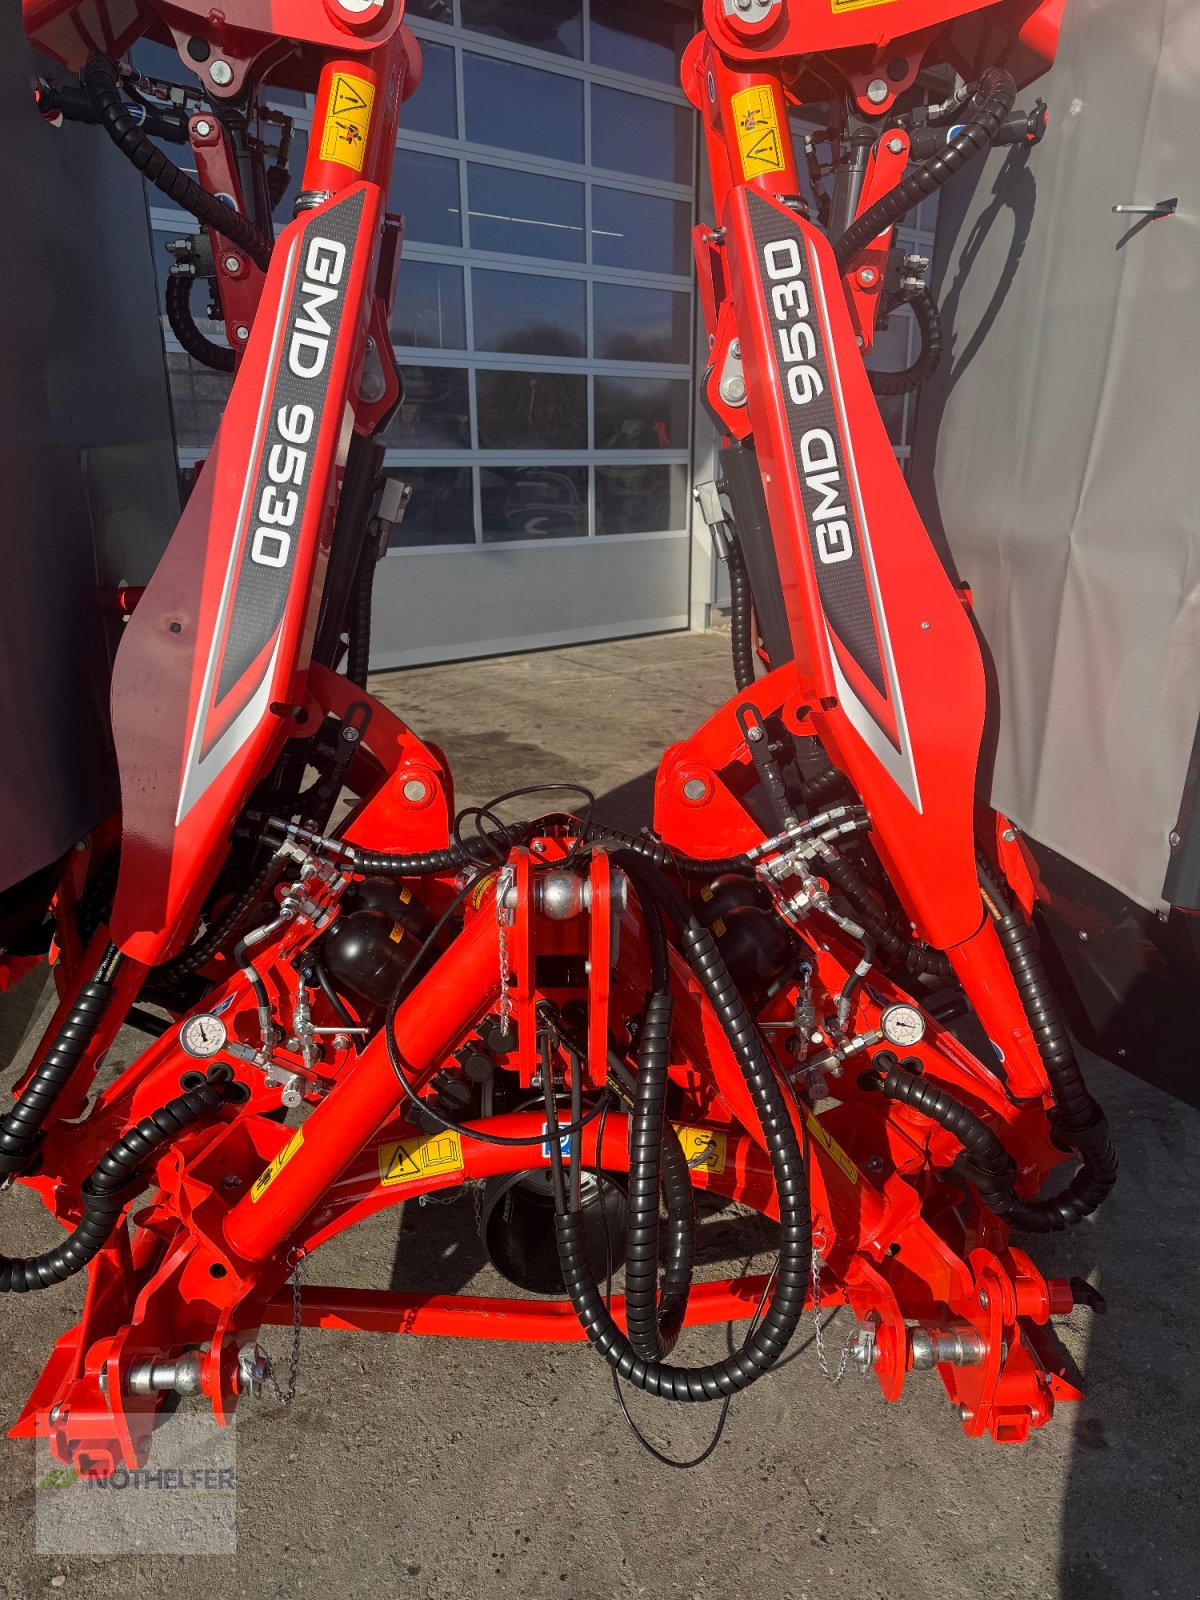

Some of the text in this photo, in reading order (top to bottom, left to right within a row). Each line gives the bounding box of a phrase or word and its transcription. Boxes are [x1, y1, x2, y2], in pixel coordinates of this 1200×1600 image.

[250, 236, 347, 569] GMD 9530
[763, 238, 853, 566] GMD 9530
